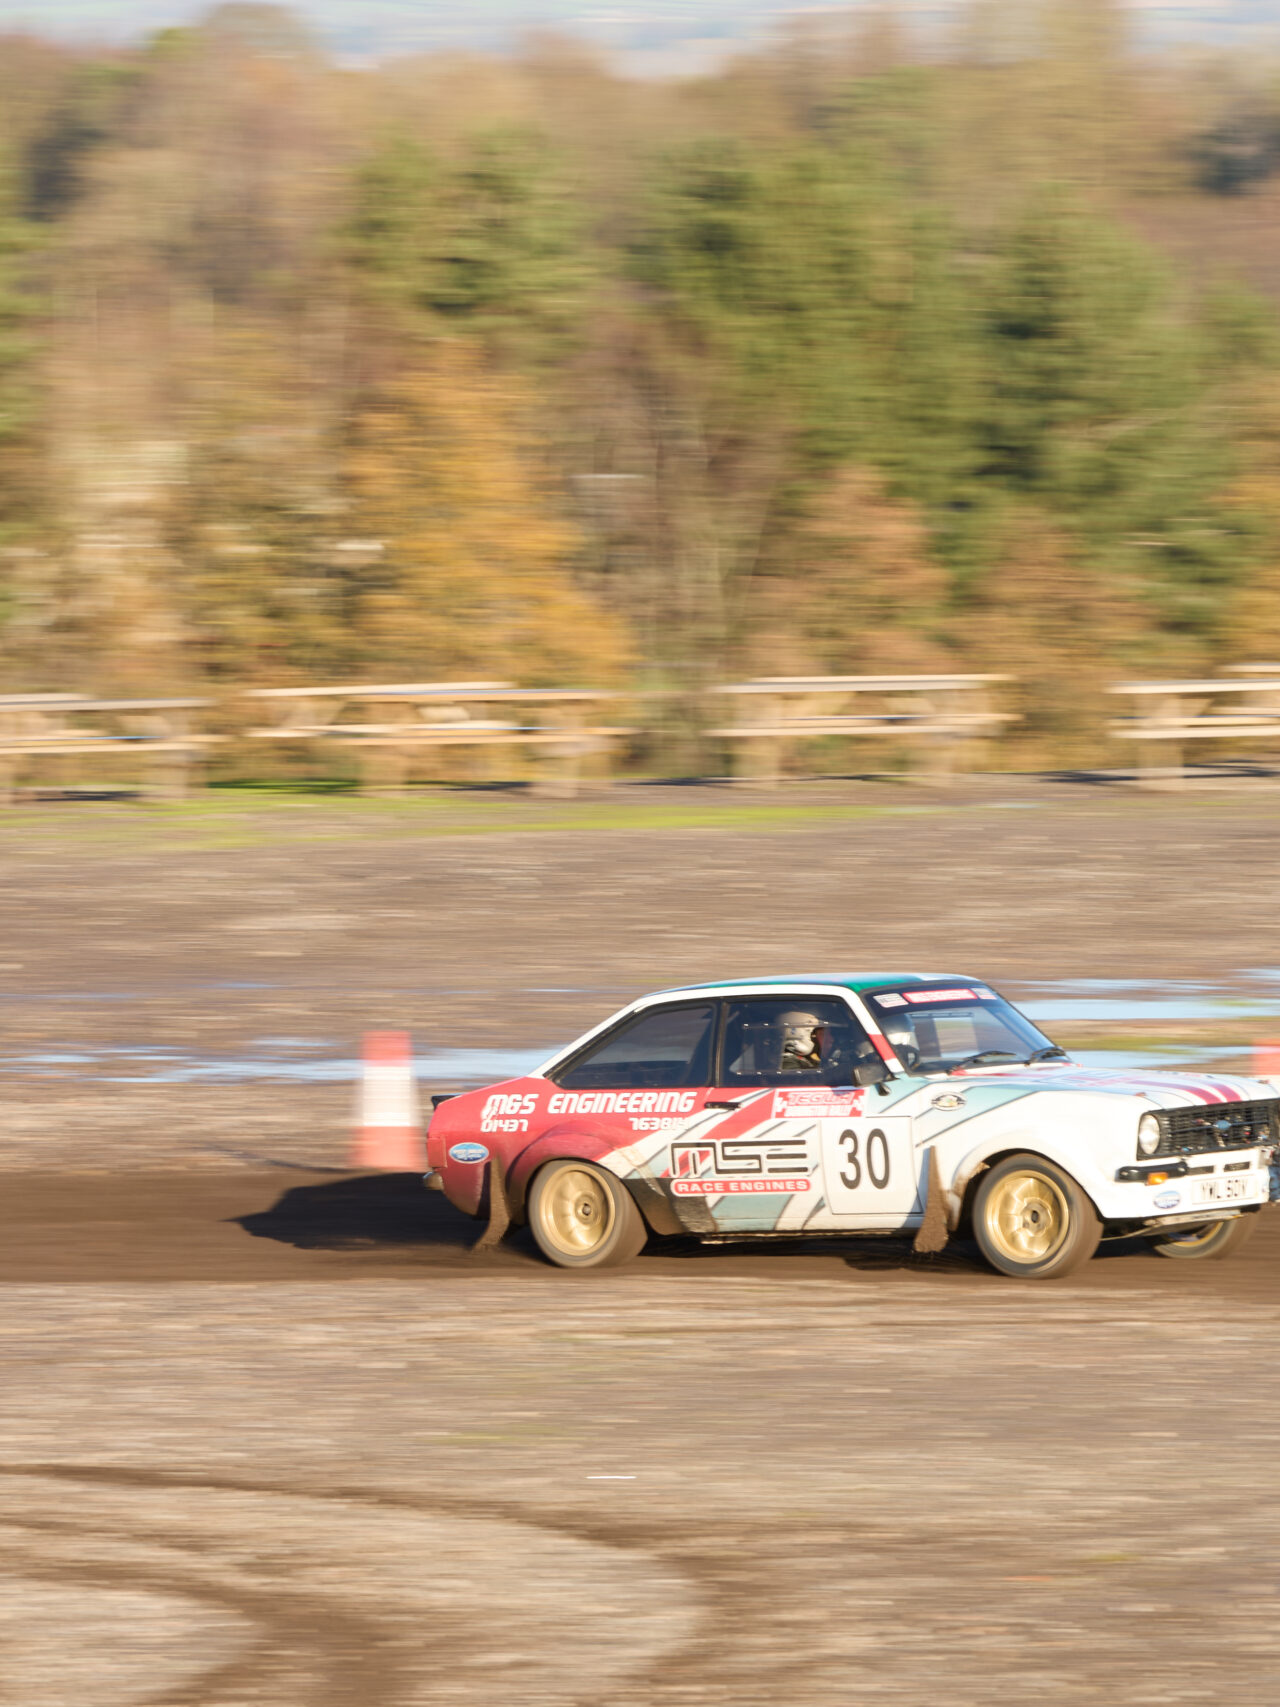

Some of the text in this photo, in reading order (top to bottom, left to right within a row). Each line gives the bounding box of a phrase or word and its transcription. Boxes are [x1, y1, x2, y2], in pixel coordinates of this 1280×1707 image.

[548, 1091, 696, 1114] ENGINEERING
[480, 1119, 529, 1132] 01437
[670, 1139, 809, 1178] MSE
[838, 1127, 891, 1190] 30
[677, 1180, 808, 1193] RACE ENGINES
